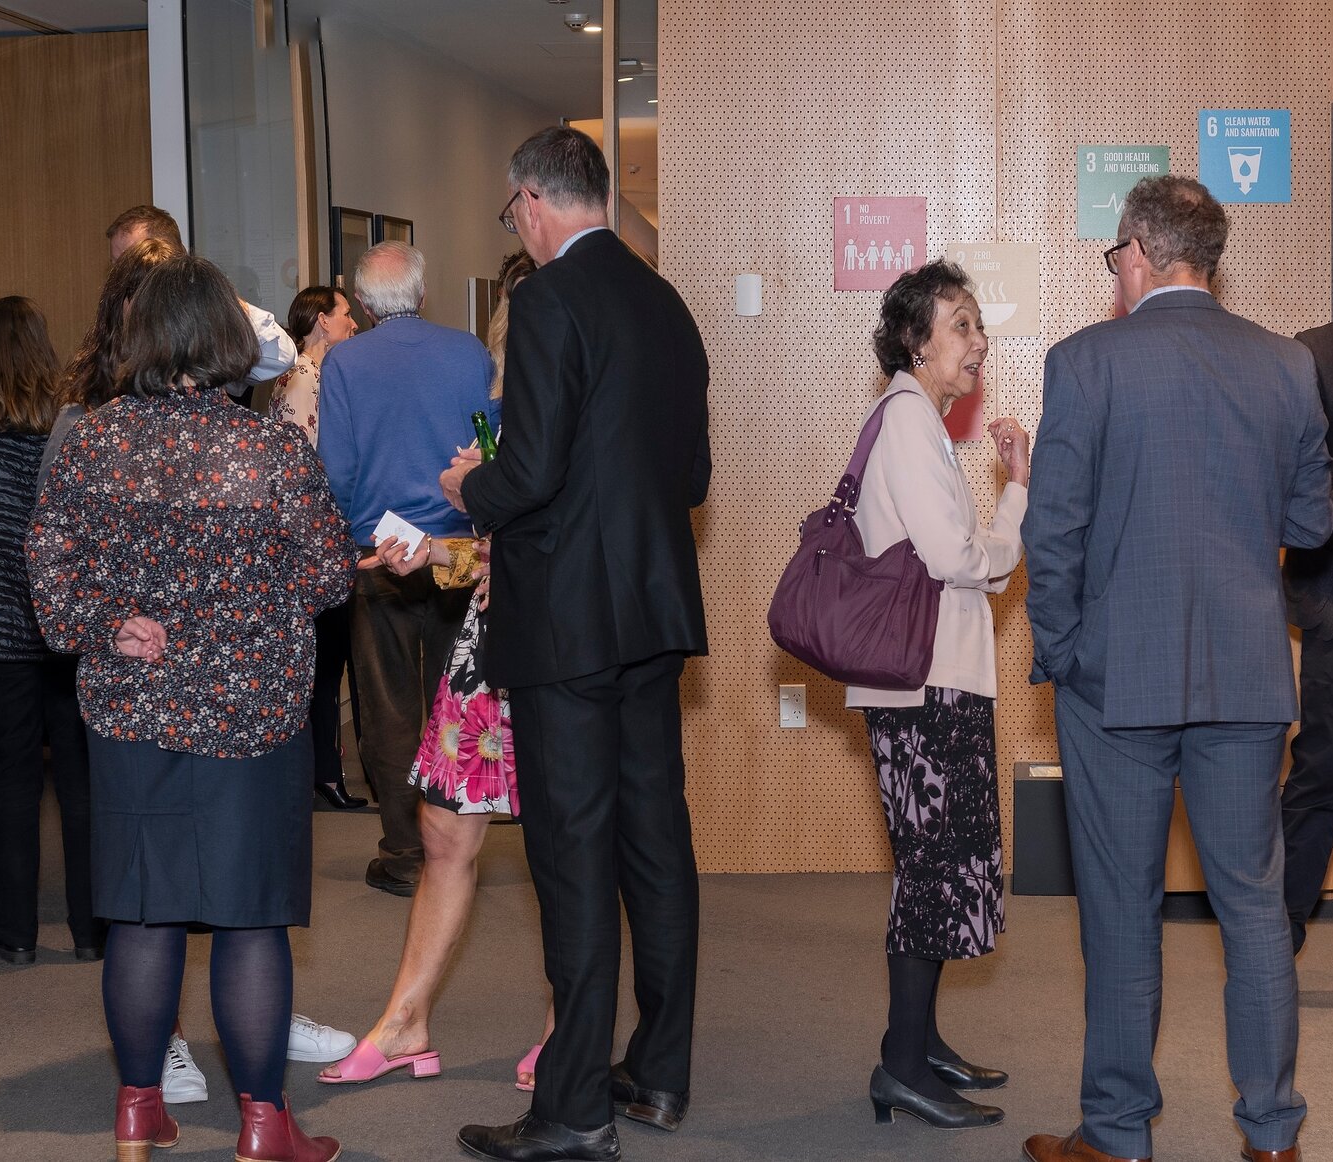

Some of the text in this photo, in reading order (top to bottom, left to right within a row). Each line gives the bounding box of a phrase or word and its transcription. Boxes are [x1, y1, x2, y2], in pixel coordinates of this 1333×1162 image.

[1224, 116, 1271, 126] CLEAN WATER
[1207, 116, 1218, 137] 6
[1224, 127, 1280, 137] AND SANITATION
[1086, 152, 1096, 173] 3
[1104, 153, 1150, 162] GOOD HEALTH
[1104, 163, 1159, 173] AND WELL-BEING
[859, 204, 870, 214] NO
[843, 204, 851, 225] 1
[859, 215, 891, 225] POVERTY
[973, 251, 991, 260] ZERO
[973, 261, 1001, 271] HUNGER
